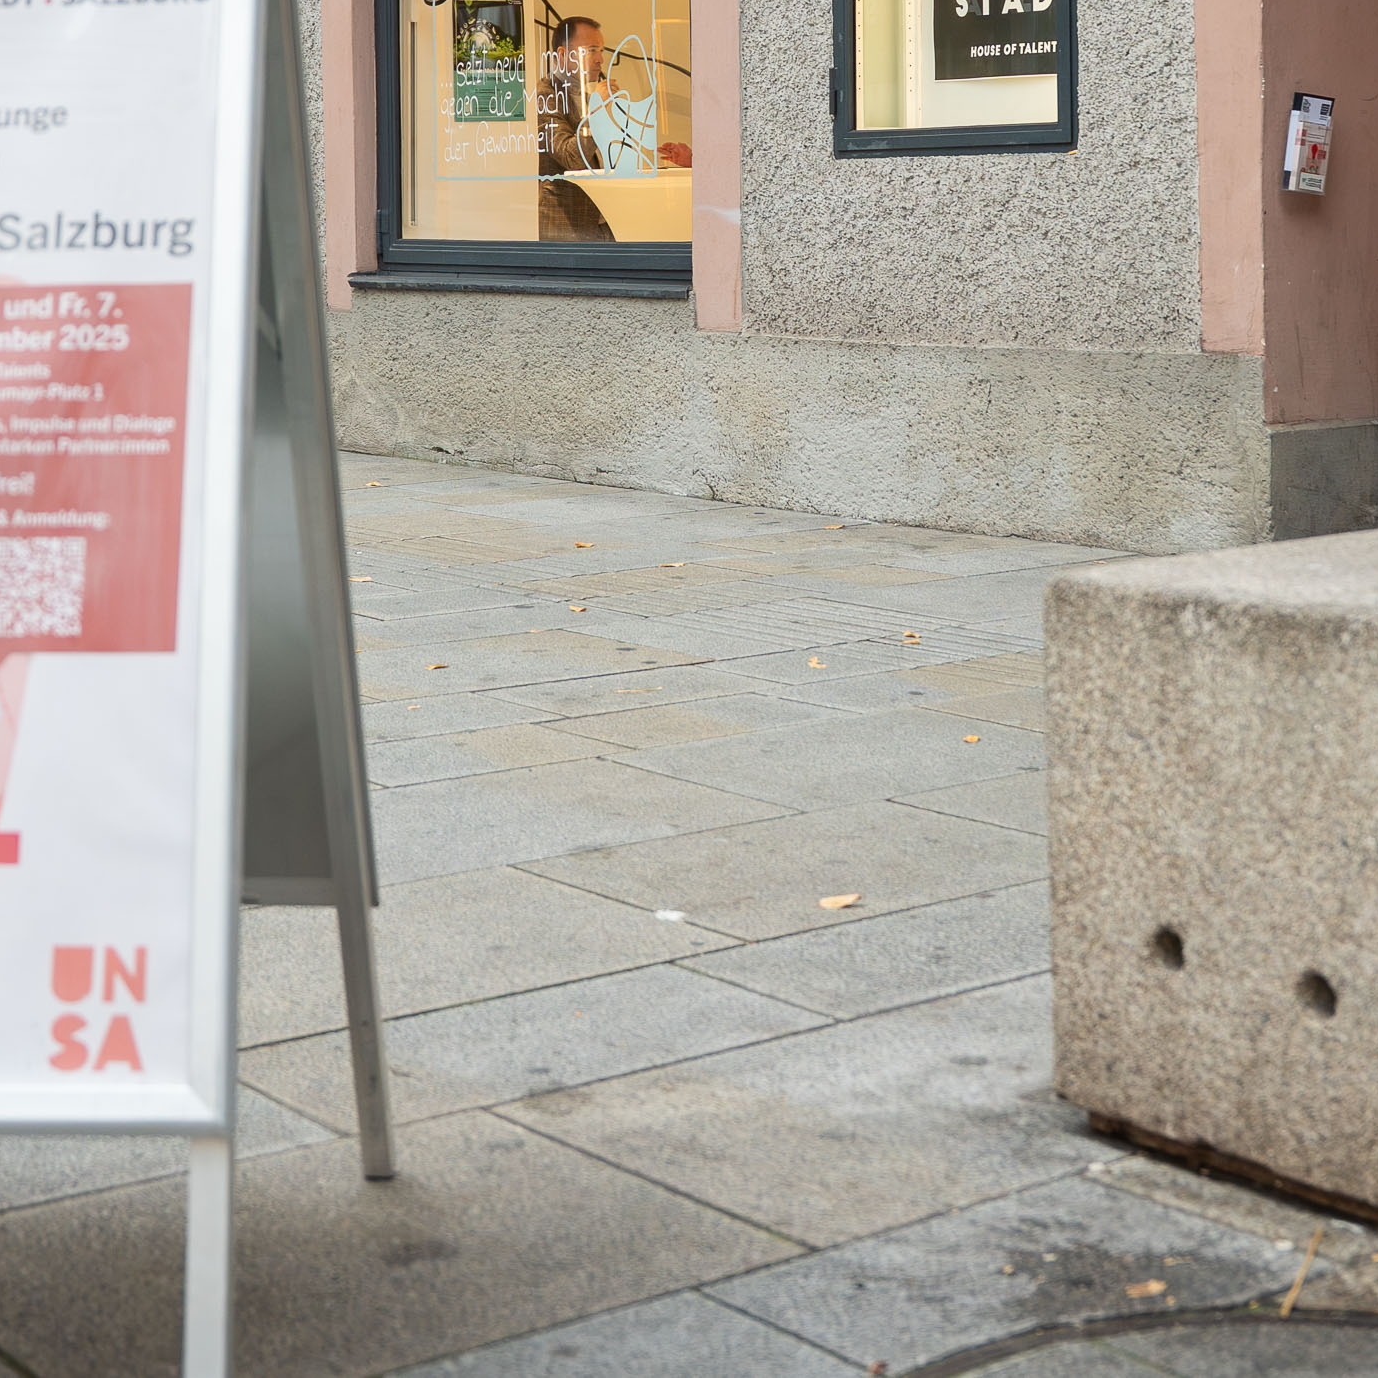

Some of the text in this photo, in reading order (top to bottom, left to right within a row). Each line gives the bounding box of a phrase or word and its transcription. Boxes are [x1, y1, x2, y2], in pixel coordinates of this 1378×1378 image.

[496, 53, 525, 84] neue
[970, 41, 1058, 58] HOUSE OF TALENT
[440, 95, 479, 133] gegen
[489, 86, 513, 117] die
[444, 118, 559, 169] der Gewohnheit
[3, 294, 53, 319] und
[58, 291, 91, 318] Fr.
[97, 290, 123, 318] 7.
[58, 324, 130, 351] 2025
[50, 944, 148, 1005] UN
[48, 1013, 144, 1072] SA
